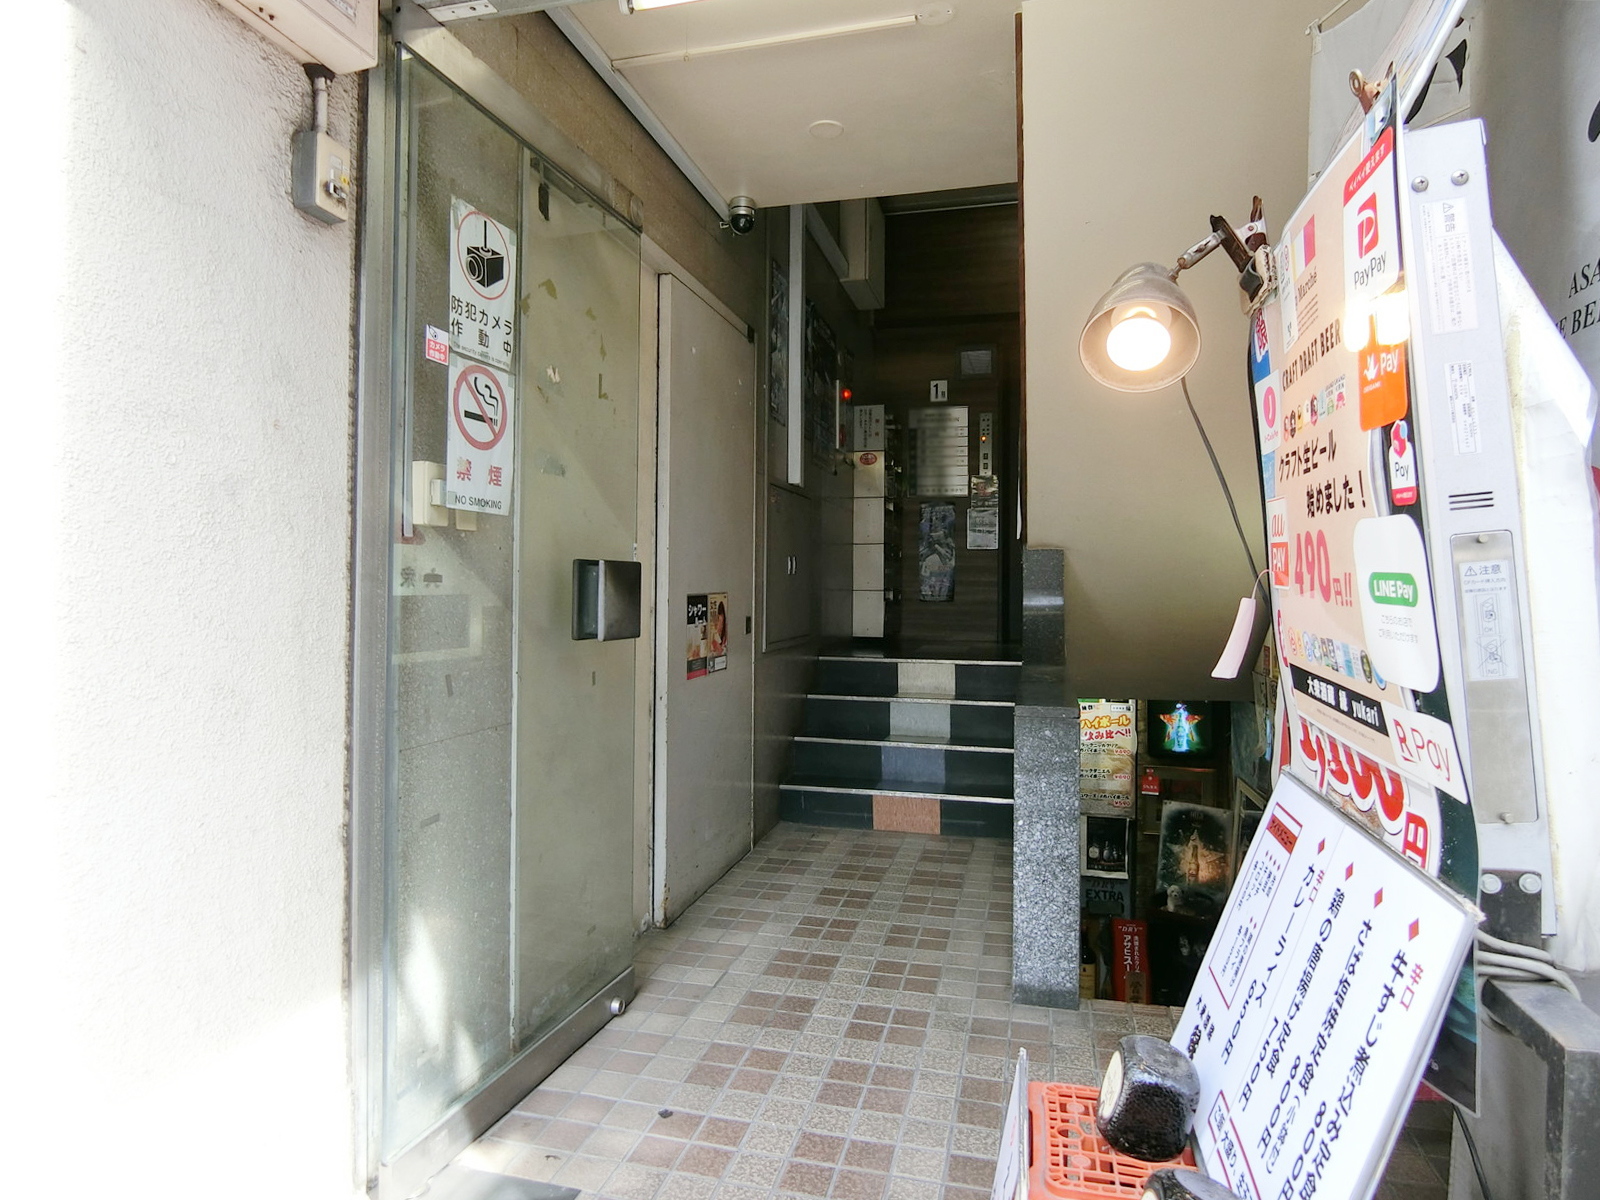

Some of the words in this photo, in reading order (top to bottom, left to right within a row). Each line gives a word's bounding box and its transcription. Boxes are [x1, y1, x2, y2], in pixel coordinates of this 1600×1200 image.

[1354, 251, 1386, 289] PayPay
[451, 294, 512, 336] 防犯カメラ
[1571, 300, 1600, 335] BE
[429, 340, 446, 352] カメラ
[1282, 359, 1298, 391] CRAFT
[1299, 338, 1318, 377] DRAFT
[1320, 318, 1341, 357] BEER
[1381, 349, 1399, 375] Pay
[1279, 429, 1336, 482] クラフト生ビール
[1394, 462, 1409, 480] Pay
[457, 458, 502, 487] 禁煙
[455, 494, 467, 505] NO
[468, 496, 502, 510] SMOKING
[1272, 513, 1285, 538] au
[1272, 547, 1286, 572] PAY
[1479, 564, 1502, 575] 注意
[1373, 579, 1396, 598] LINE
[1396, 581, 1413, 602] Pay
[1080, 714, 1131, 729] ハイボール
[1351, 700, 1379, 727] yukari
[1410, 727, 1450, 782] Pay
[1086, 889, 1124, 901] EXTRA
[1255, 863, 1315, 1008] カレーライス
[1221, 979, 1257, 1065] 650円
[1239, 1016, 1279, 1112] 750円
[1299, 949, 1408, 1200] 牛すじ煮込み定食
[1257, 1055, 1301, 1159] 800円
[1278, 1101, 1326, 1200] 800円
